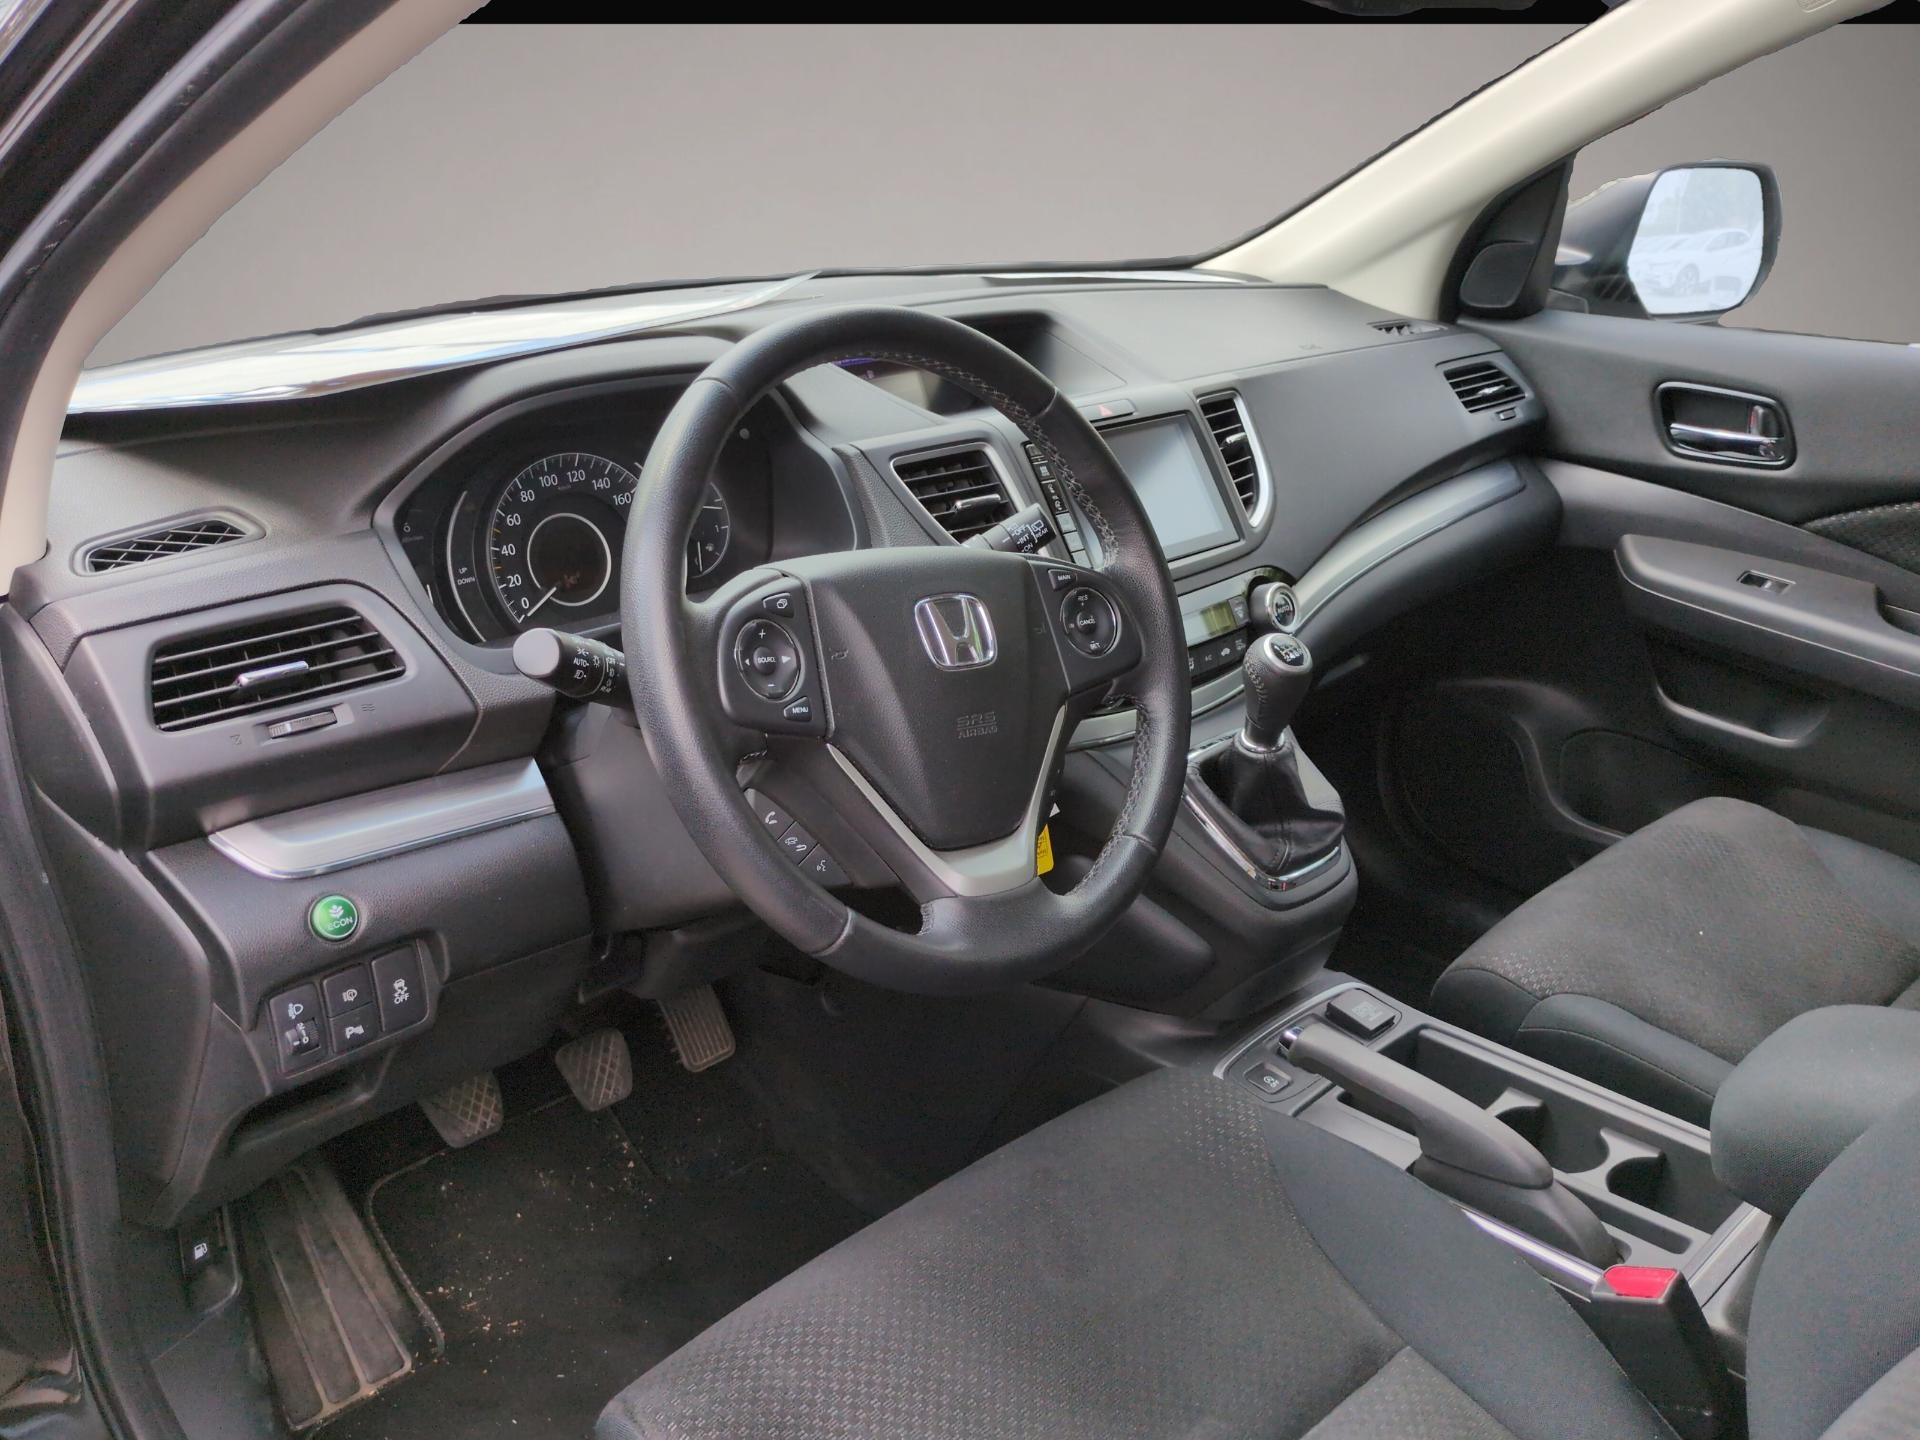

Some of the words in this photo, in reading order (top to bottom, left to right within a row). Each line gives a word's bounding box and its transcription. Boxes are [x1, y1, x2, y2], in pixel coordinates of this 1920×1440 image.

[539, 474, 558, 487] 100
[567, 470, 586, 482] 120
[592, 477, 611, 490] 140
[520, 489, 535, 502] 80
[613, 492, 632, 505] 160
[506, 513, 521, 526] 60
[501, 543, 516, 556] 40
[457, 576, 476, 586] DOWN
[507, 574, 522, 588] 20
[521, 597, 530, 609] 0
[573, 657, 587, 667] AUTO
[957, 711, 996, 727] SRS
[393, 992, 409, 1004] OFF
